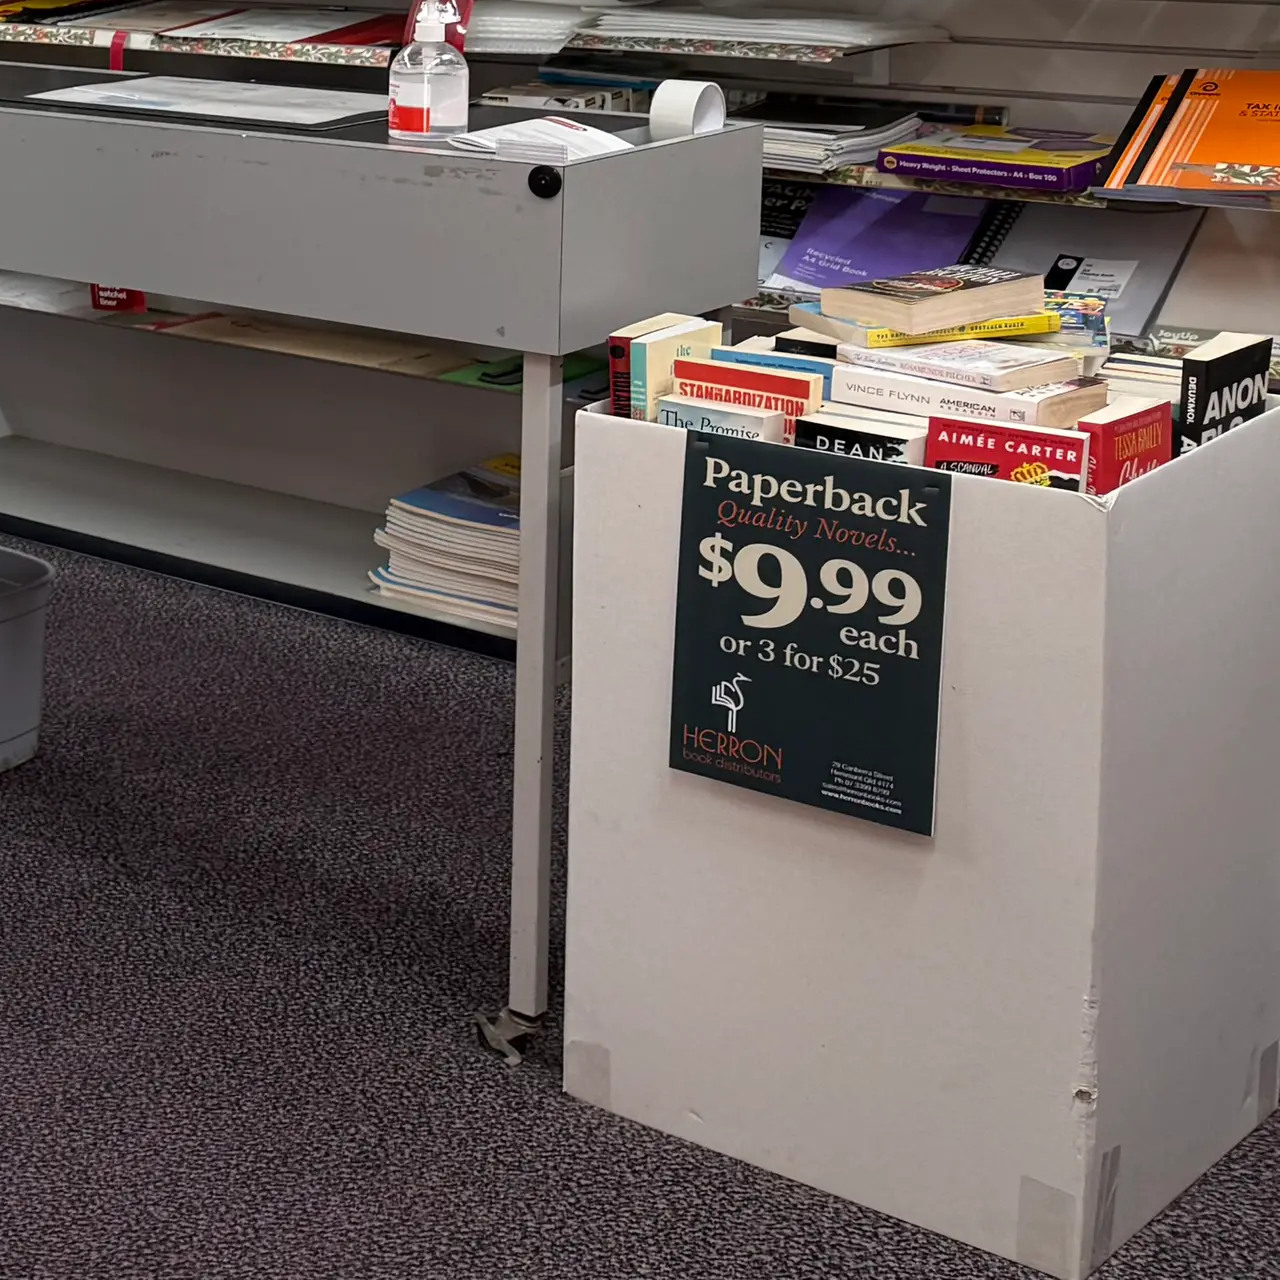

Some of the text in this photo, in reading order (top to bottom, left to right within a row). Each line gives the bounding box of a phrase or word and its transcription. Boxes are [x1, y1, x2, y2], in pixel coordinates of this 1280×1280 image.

[900, 161, 920, 169] Heavy
[922, 163, 945, 172] Weight
[951, 165, 970, 173] Sheet
[972, 167, 1007, 177] Protectors
[807, 247, 851, 265] Recycled
[818, 258, 840, 268] Grid
[842, 265, 868, 276] Book
[1158, 330, 1199, 341] JoyUp
[846, 382, 997, 413] VINCE FLYNN AMERICAN
[1203, 370, 1269, 425] ANON
[661, 409, 760, 439] The Promise
[816, 435, 883, 461] DEAN
[938, 431, 996, 450] AIMÉE
[1005, 440, 1078, 462] CARTER
[1114, 431, 1137, 461] TESSA
[950, 462, 993, 474] SCANDAL
[703, 457, 927, 528] Paperback
[717, 500, 916, 557] Quality Novels...
[698, 532, 923, 629] $9.99
[839, 625, 920, 661] each
[720, 635, 881, 686] or 3 for $25
[683, 724, 783, 771] HERRON
[683, 748, 781, 784] book distributors
